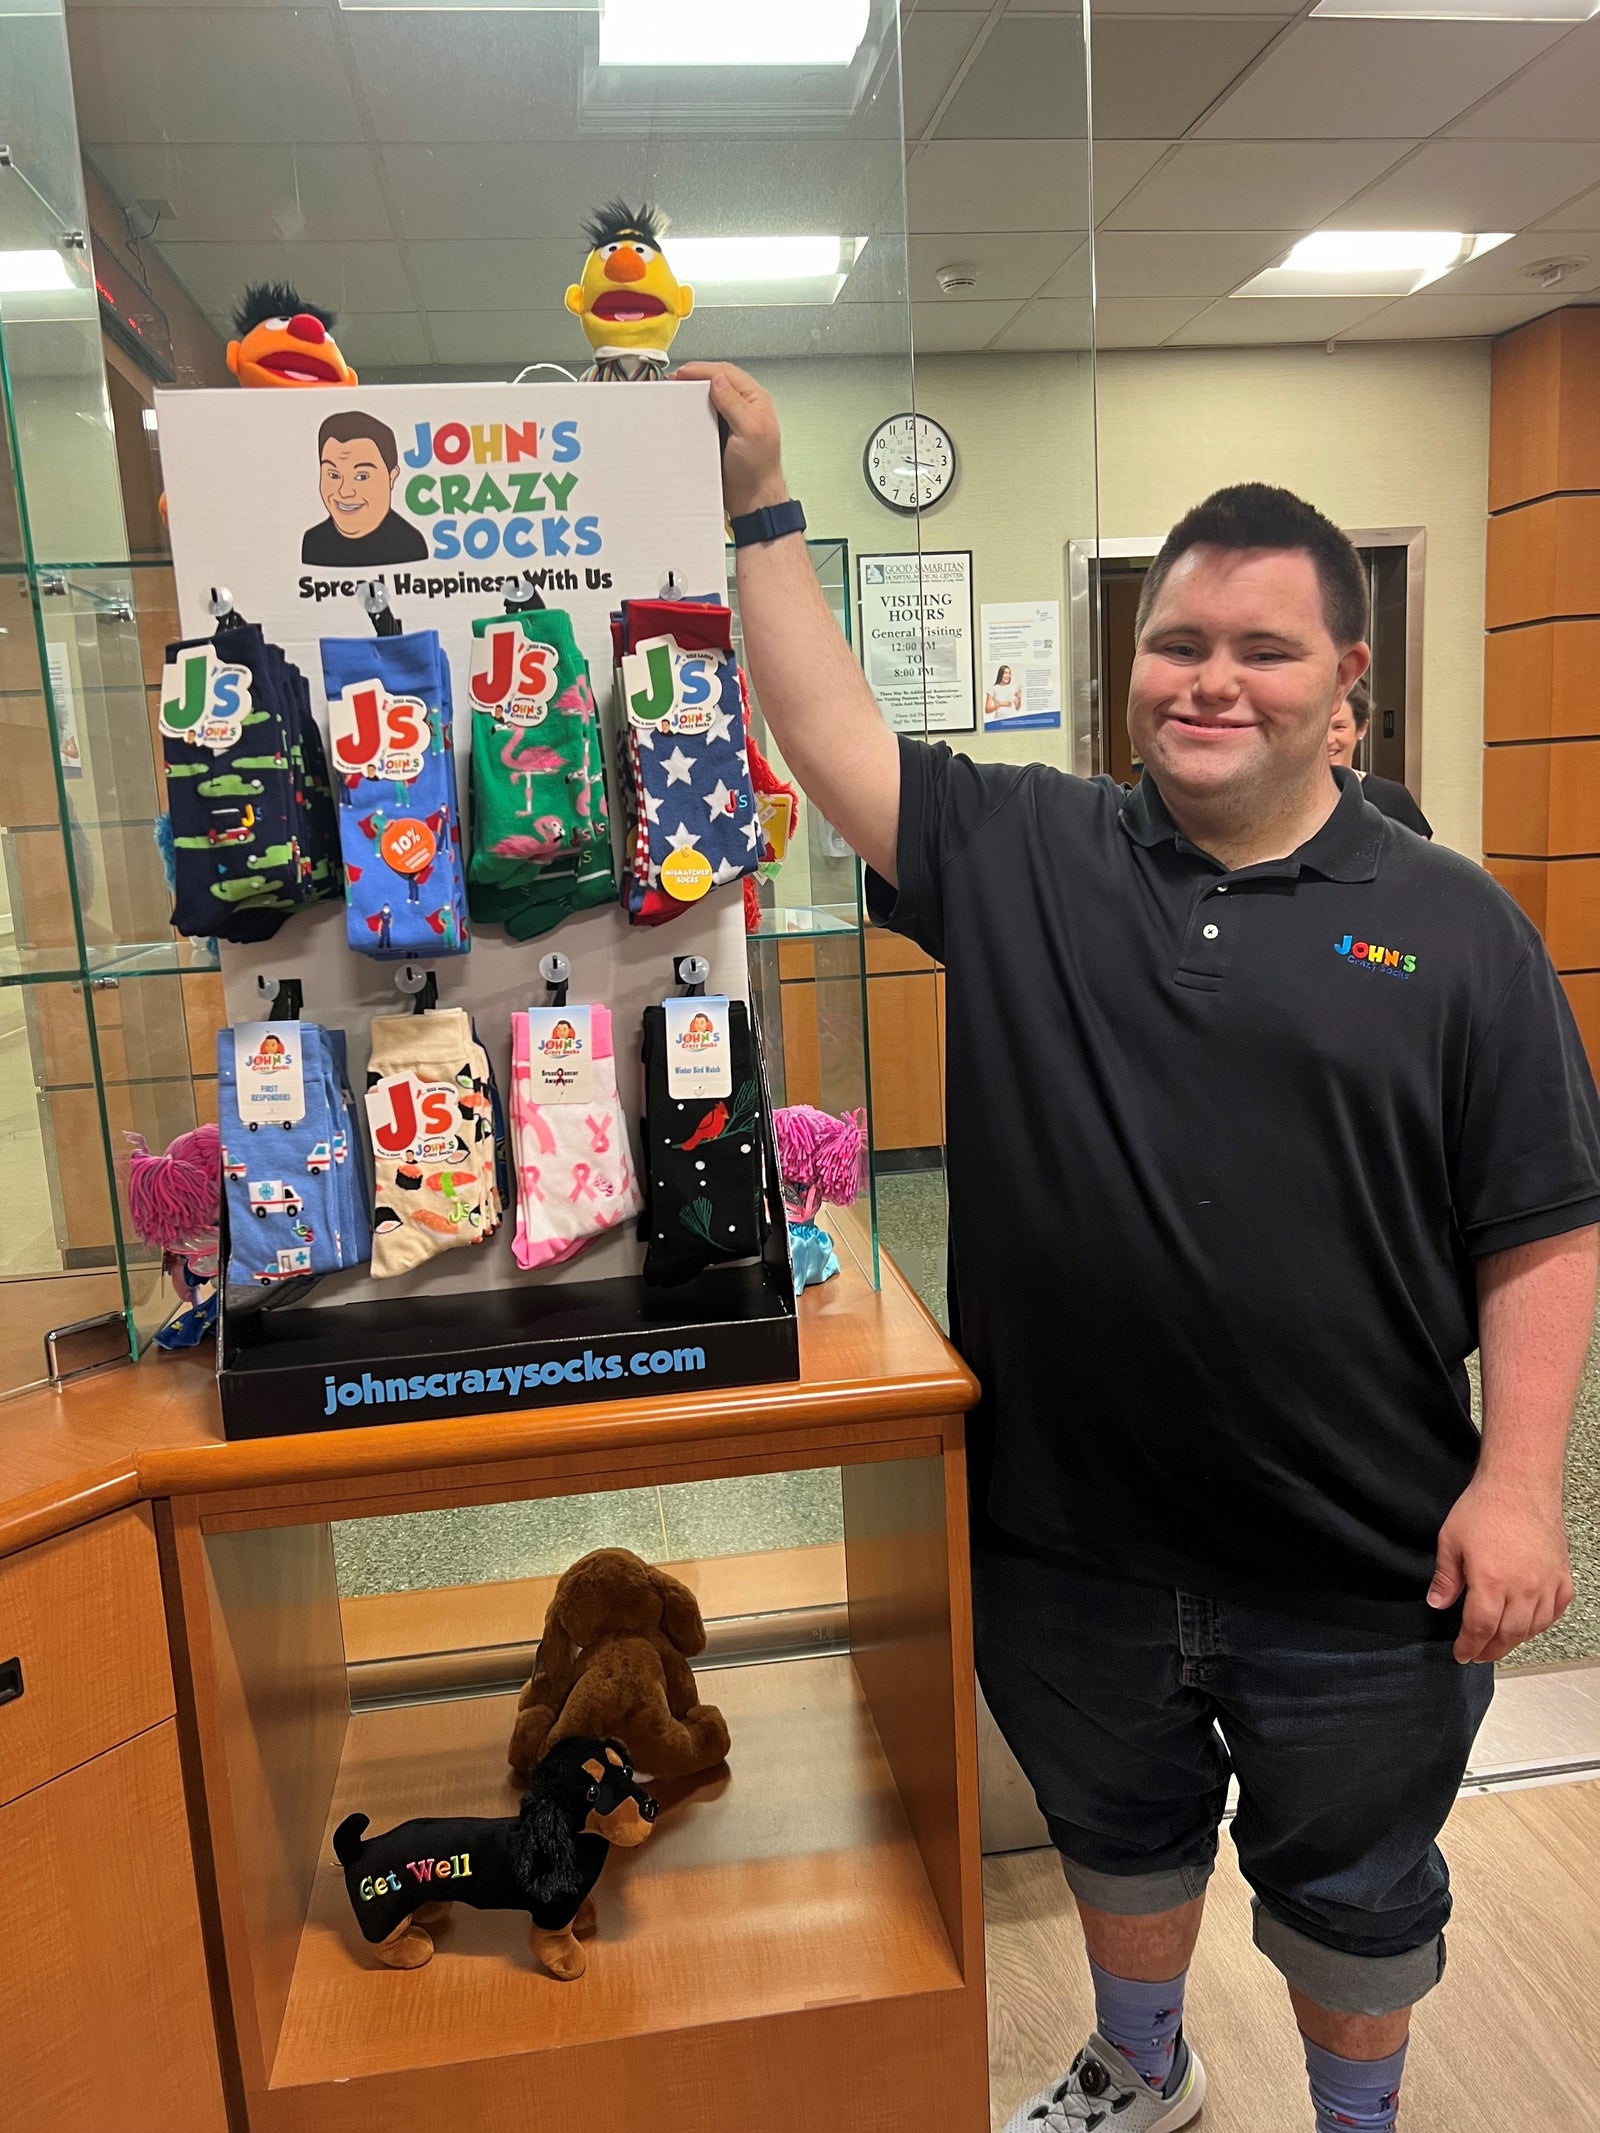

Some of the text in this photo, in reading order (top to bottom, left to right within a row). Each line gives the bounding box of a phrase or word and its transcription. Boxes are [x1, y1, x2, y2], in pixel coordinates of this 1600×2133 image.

[889, 425, 896, 435] 11
[905, 420, 915, 430] 12
[403, 421, 582, 468] JOHN'S
[876, 438, 886, 449] 10
[936, 437, 942, 448] 2
[873, 457, 880, 468] 9
[941, 455, 947, 466] 3
[879, 475, 886, 486] 8
[935, 474, 942, 485] 4
[405, 471, 579, 516] CRAZY
[893, 489, 899, 500] 7
[909, 492, 917, 503] 6
[925, 488, 932, 499] 5
[432, 515, 603, 560] SOCKS
[885, 564, 913, 574] GOOD
[298, 573, 386, 602] Spred
[522, 567, 579, 590] With
[585, 568, 613, 590] Us
[880, 594, 952, 607] VISITING
[888, 608, 945, 622] HOURS
[871, 627, 916, 639] General
[891, 642, 917, 652] 12:00
[906, 654, 922, 664] TO
[894, 668, 915, 677] 8:00
[391, 827, 421, 855] 10%
[1334, 935, 1417, 972] JOHN'S
[1380, 964, 1411, 980] Socks
[323, 1346, 706, 1415] johnscrazysocks.com
[360, 1853, 472, 1901] Get Well
